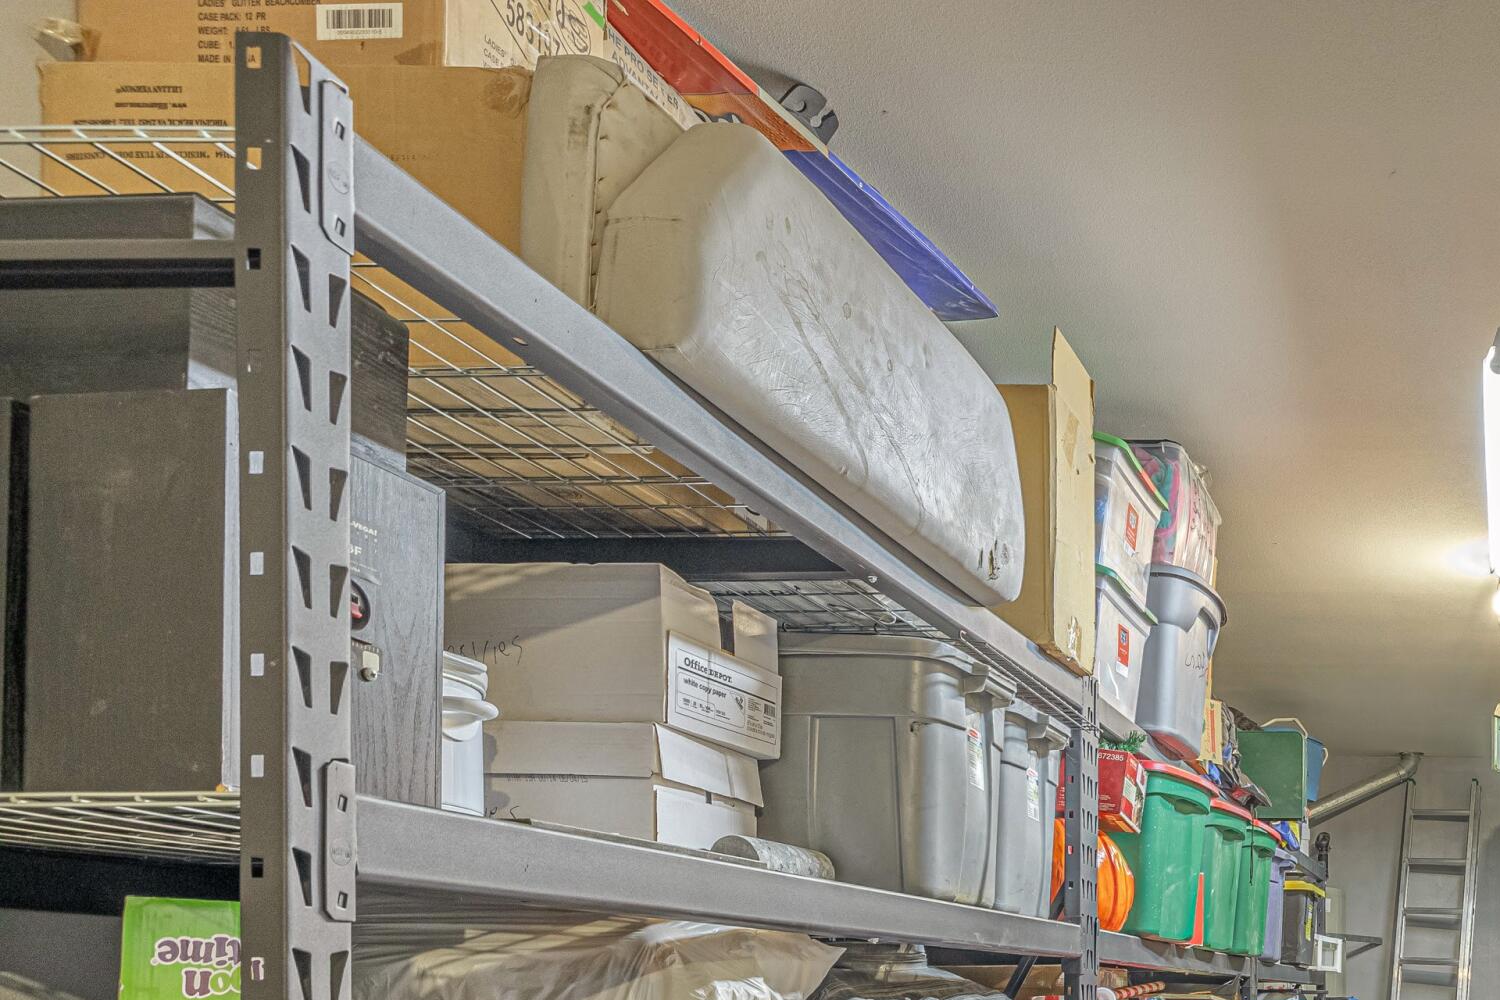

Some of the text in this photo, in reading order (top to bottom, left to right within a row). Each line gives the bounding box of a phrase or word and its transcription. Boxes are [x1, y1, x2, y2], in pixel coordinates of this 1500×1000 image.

[199, 13, 219, 21] CASE
[255, 12, 266, 21] PR
[198, 26, 228, 35] WEIGHT:
[198, 41, 221, 49] CUBE:
[198, 54, 231, 63] MADE IN
[624, 45, 643, 74] PRO
[683, 657, 708, 674] Office
[683, 678, 727, 699] white copy paper
